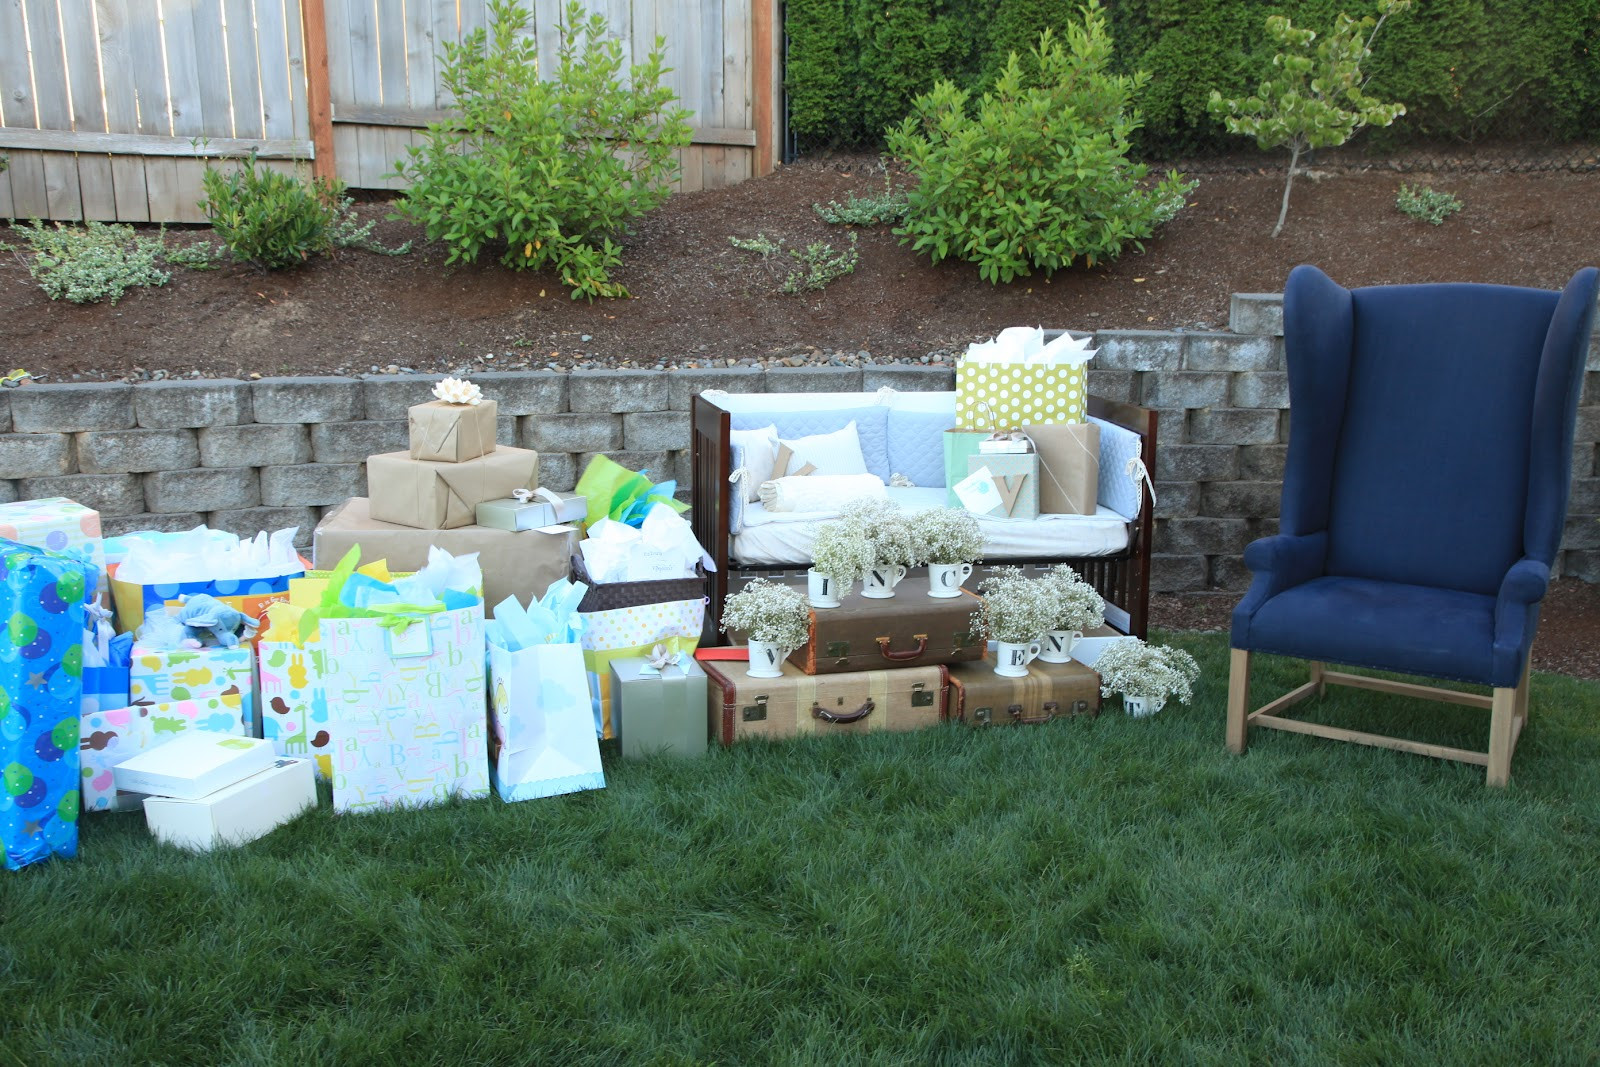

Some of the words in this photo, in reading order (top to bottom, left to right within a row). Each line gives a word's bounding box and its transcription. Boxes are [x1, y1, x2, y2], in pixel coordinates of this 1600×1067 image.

[992, 474, 1028, 517] V
[821, 578, 829, 596] I
[869, 569, 888, 587] N
[940, 570, 957, 588] C
[1047, 635, 1064, 652] N
[765, 647, 781, 665] V
[1010, 650, 1025, 666] E
